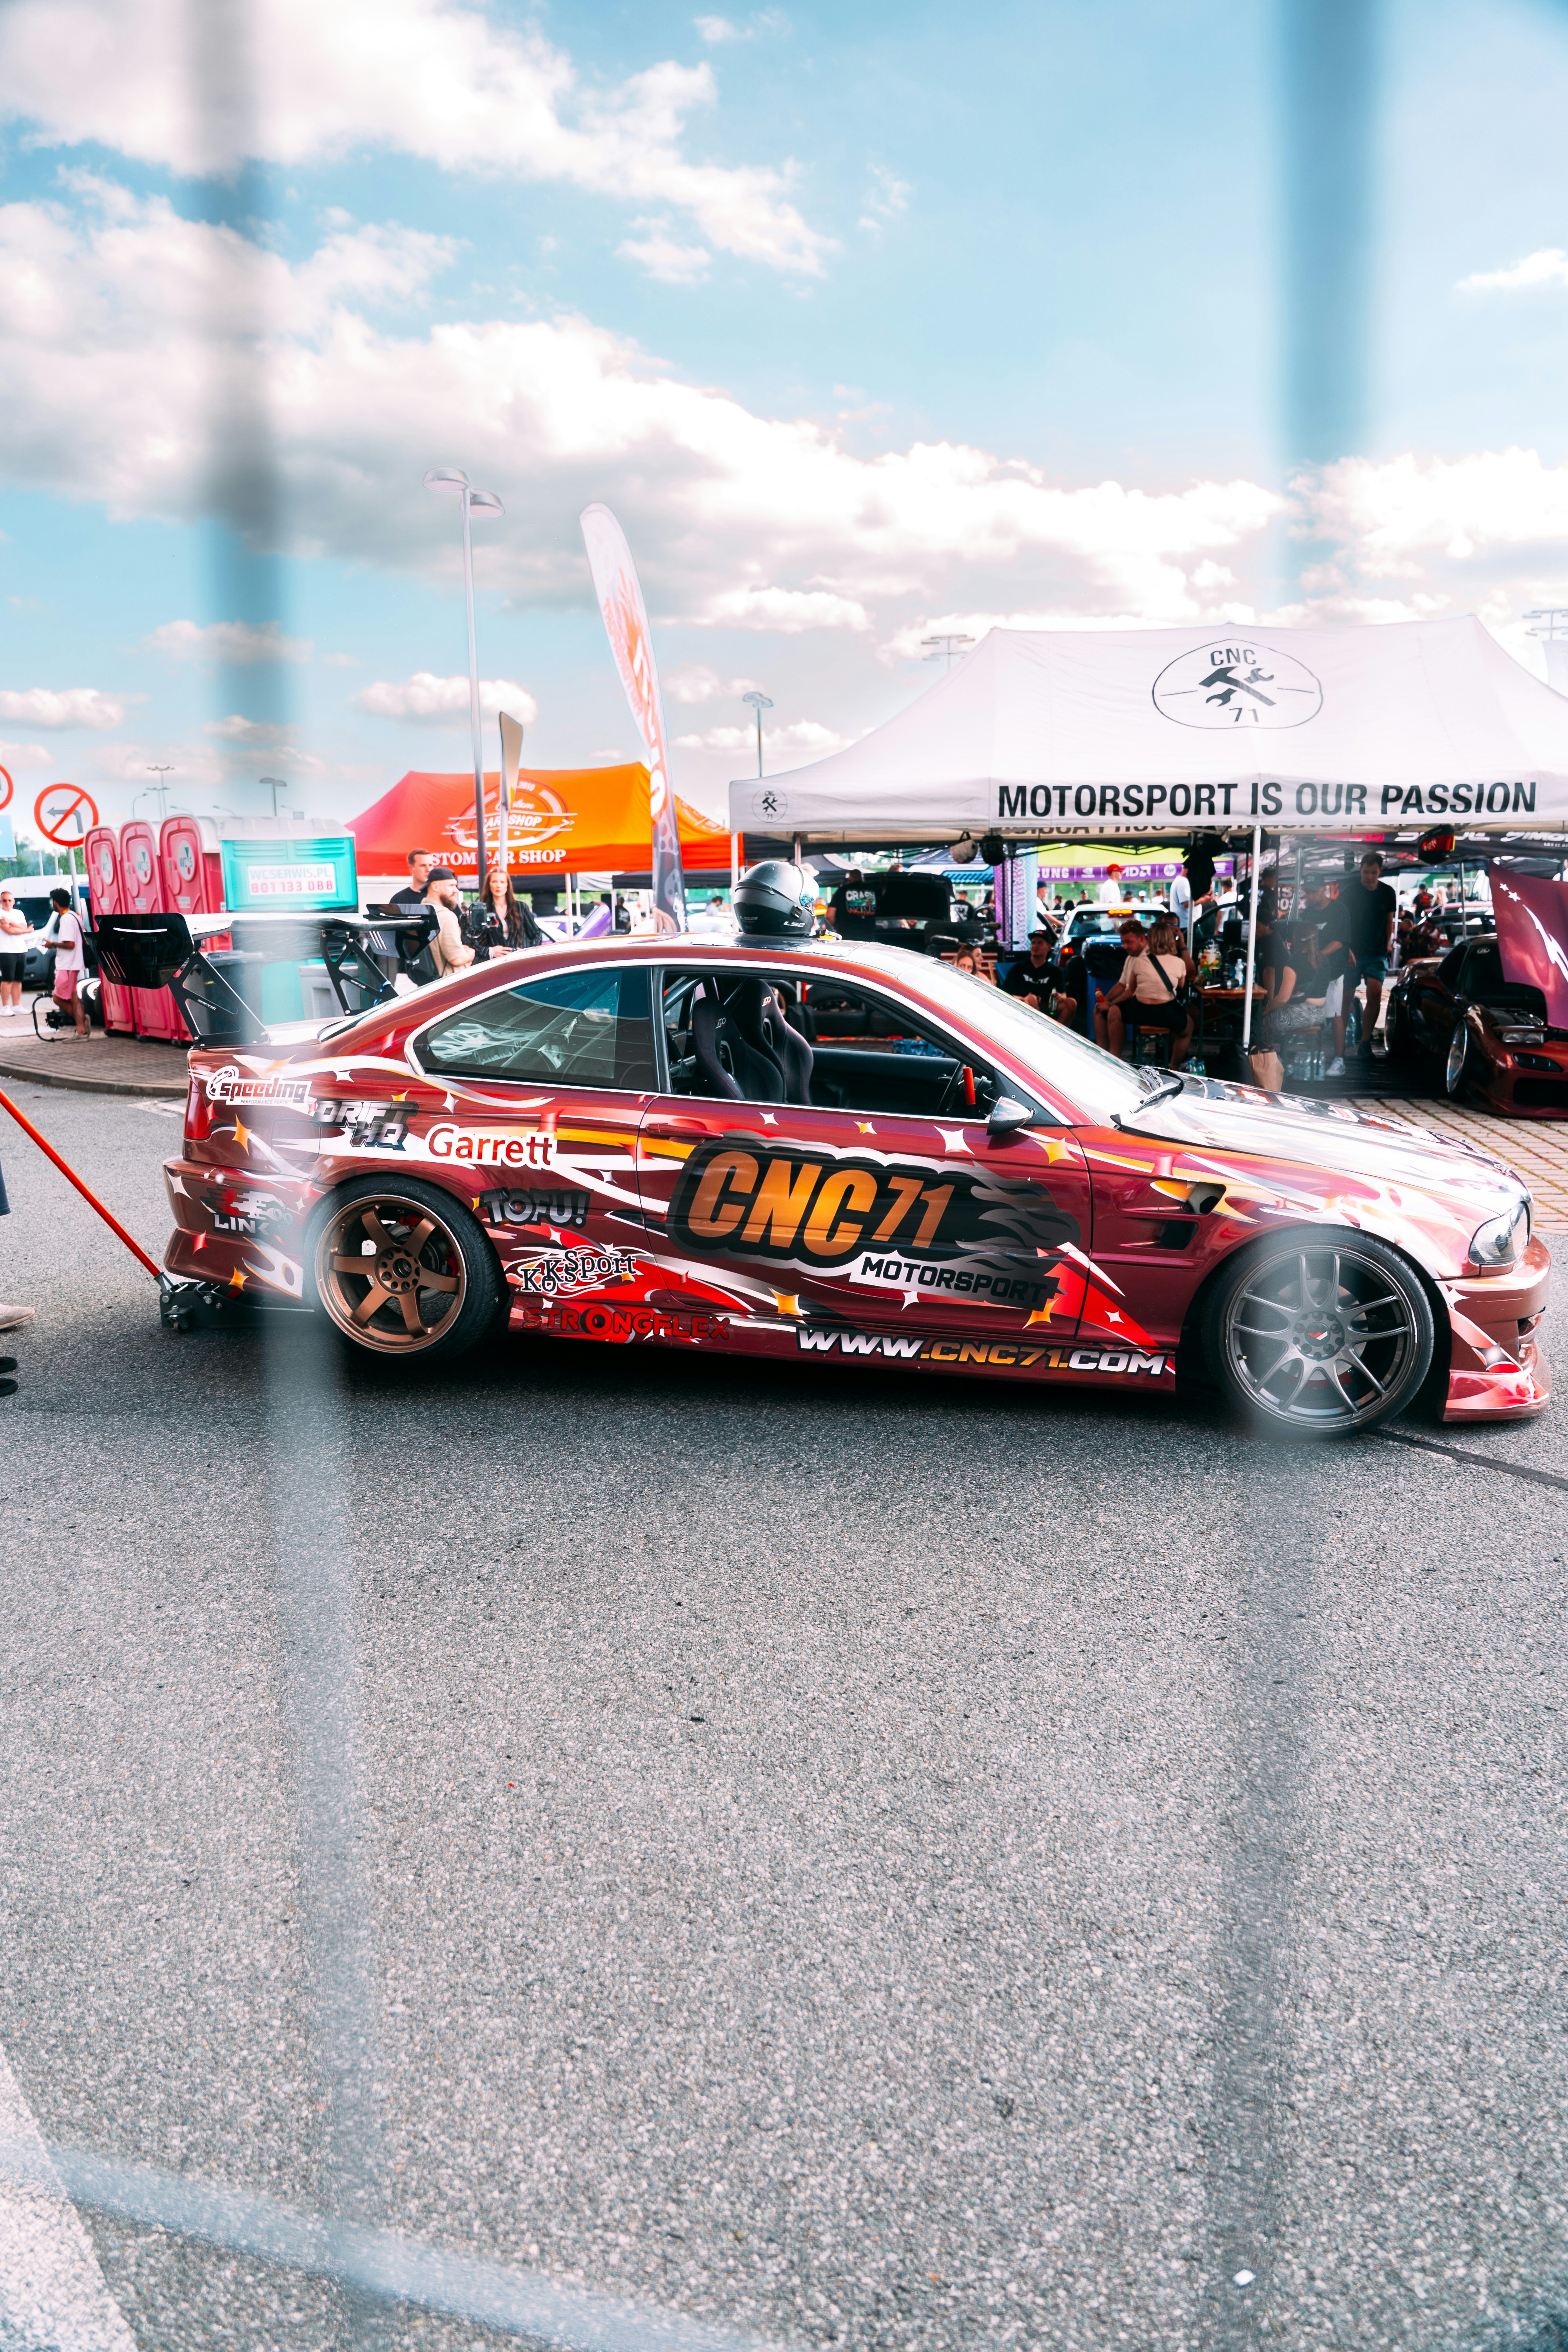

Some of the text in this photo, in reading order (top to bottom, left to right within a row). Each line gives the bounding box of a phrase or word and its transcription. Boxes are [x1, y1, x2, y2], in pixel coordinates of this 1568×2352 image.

[1210, 648, 1256, 666] CNC
[1229, 708, 1259, 722] 71
[998, 782, 1536, 817] MOTORSPORT IS OUR PASSION
[508, 813, 543, 828] SHOP
[1500, 831, 1568, 842] SIMO
[431, 851, 477, 866] STOM
[519, 849, 566, 863] SHOP
[250, 868, 332, 880] WCSERWIS.PL
[251, 880, 333, 893] 801 133 088
[315, 1101, 418, 1124] DRIFT
[352, 1121, 404, 1145] HQ
[428, 1127, 552, 1166] Garrett
[483, 1192, 587, 1224] TOFU!
[214, 1214, 270, 1236] LINK
[861, 1256, 1048, 1303] MOTORSPORT
[523, 1307, 730, 1340] STRONGFLEX
[799, 1330, 1165, 1374] WWW.CNC71.COM
